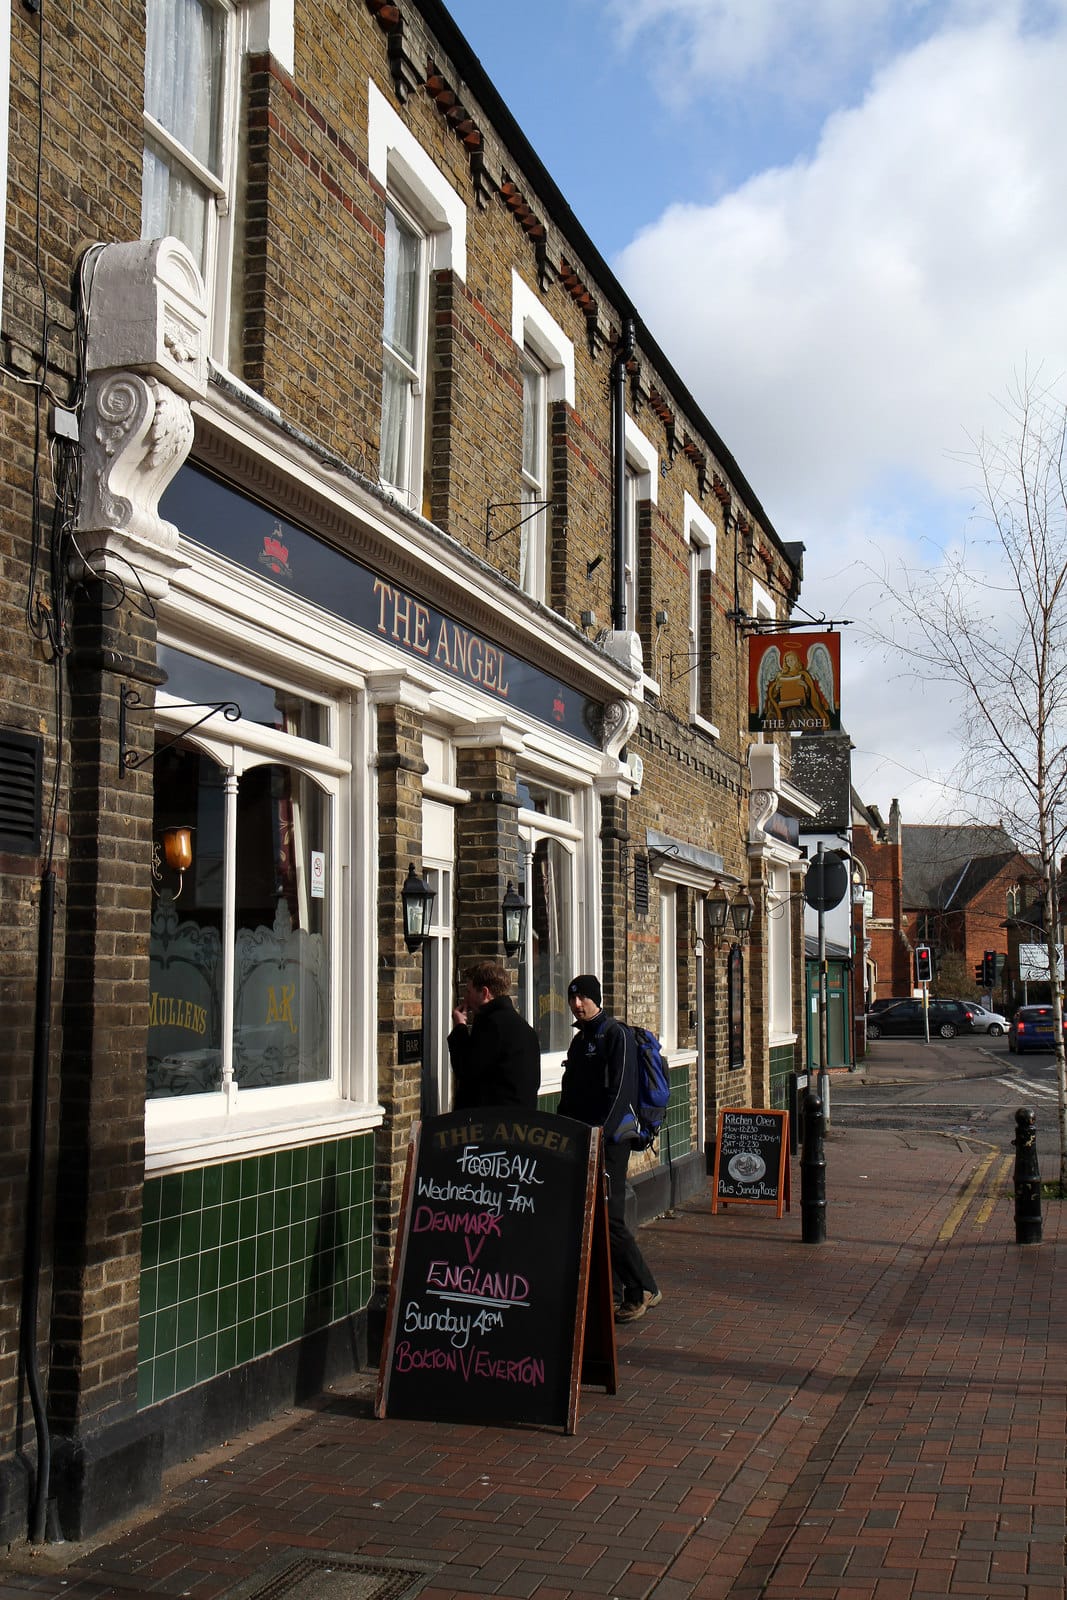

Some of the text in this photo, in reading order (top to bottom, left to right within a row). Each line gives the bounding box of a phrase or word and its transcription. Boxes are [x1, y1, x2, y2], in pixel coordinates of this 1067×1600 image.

[373, 577, 510, 698] THE ANGEL
[761, 718, 831, 729] THE ANGEL
[434, 1121, 573, 1153] THE ANGEL
[418, 1176, 503, 1218] Wednesday
[413, 1205, 504, 1237] DENMARK
[426, 1260, 530, 1300] ENGLAND
[403, 1301, 471, 1349] Sunday
[474, 1350, 545, 1387] EVERTON
